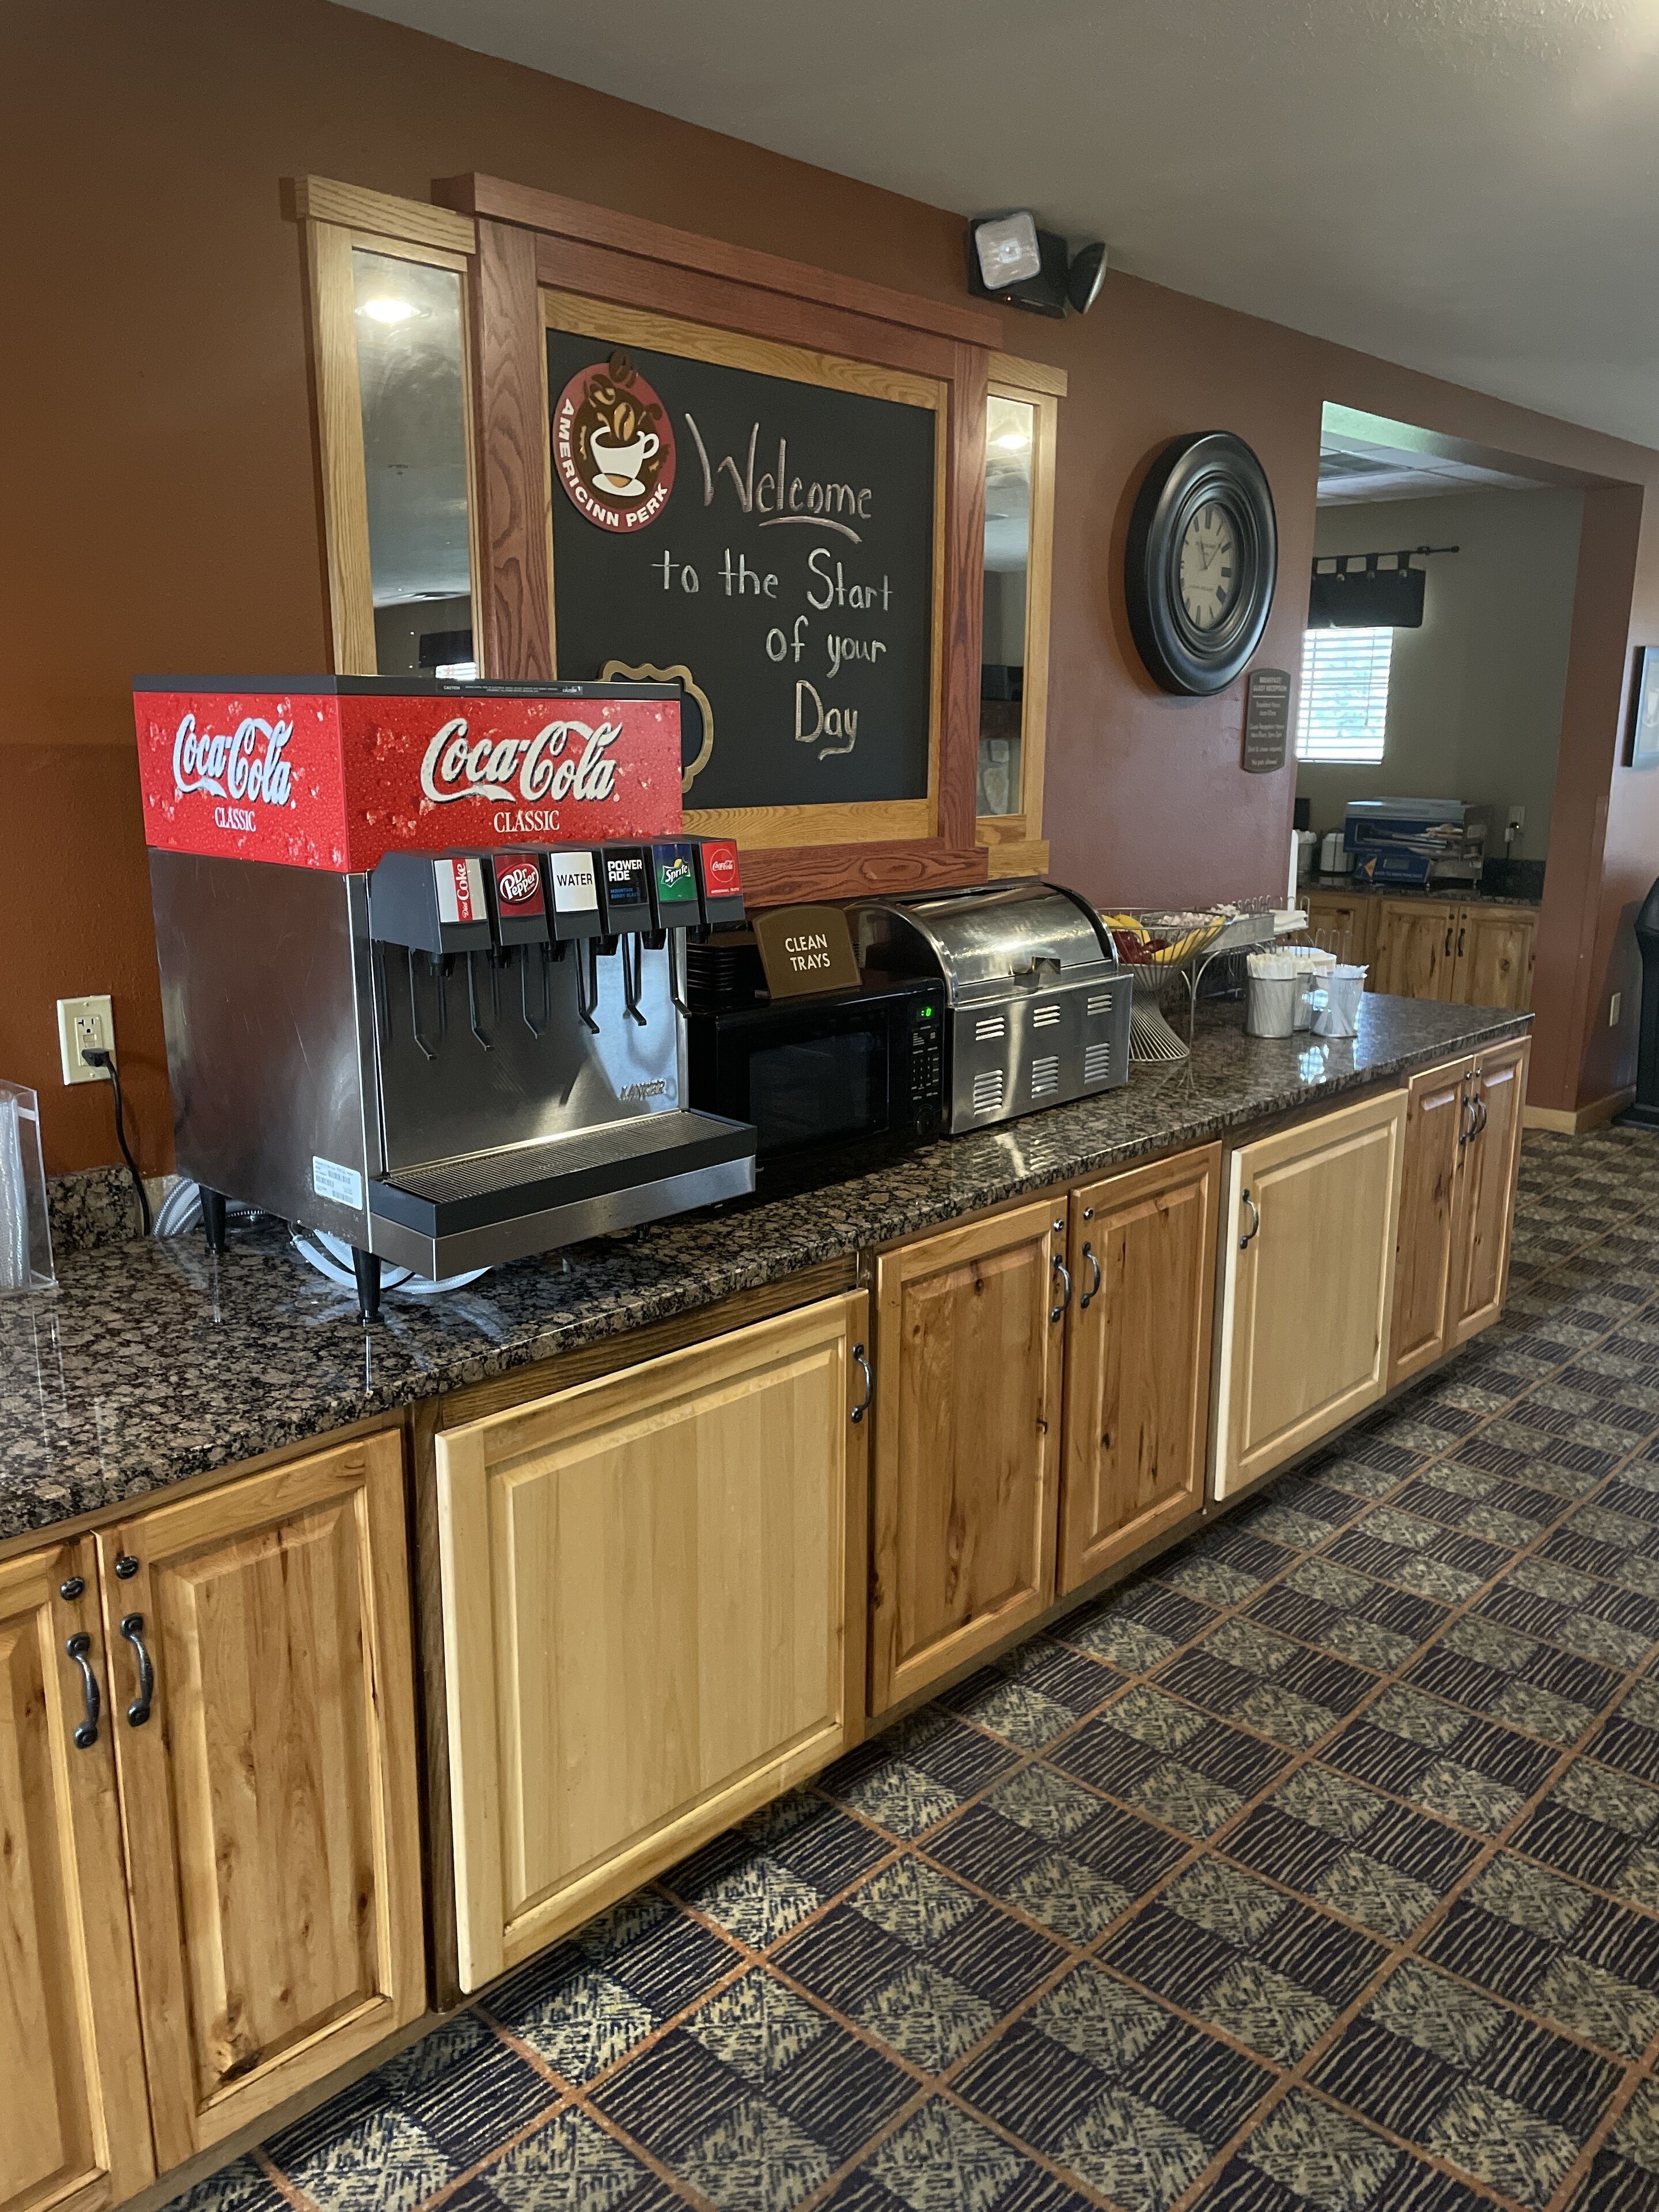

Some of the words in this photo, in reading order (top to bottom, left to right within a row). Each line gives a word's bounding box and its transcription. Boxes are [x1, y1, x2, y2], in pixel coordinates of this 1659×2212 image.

[559, 399, 619, 527] AMERICINN
[626, 483, 668, 527] PERK
[684, 412, 872, 519] Welcome
[651, 550, 698, 593] to
[718, 548, 778, 599] the
[807, 548, 893, 611] Start
[827, 632, 887, 678] your
[795, 680, 858, 760] Day
[173, 713, 294, 806] Coca-Cola
[421, 717, 623, 804] Coca-Cola
[214, 806, 256, 832] CLASSIC
[494, 810, 560, 833] CLASSIC
[512, 868, 528, 881] Dr
[607, 859, 642, 871] POWER
[608, 870, 630, 882] ADE
[665, 863, 688, 883] Sprite
[455, 863, 470, 901] Coke
[503, 870, 537, 900] Pepper
[556, 873, 593, 886] WATER
[461, 901, 469, 919] Diet
[785, 934, 828, 952] CLEAN
[790, 953, 831, 971] TRAYS
